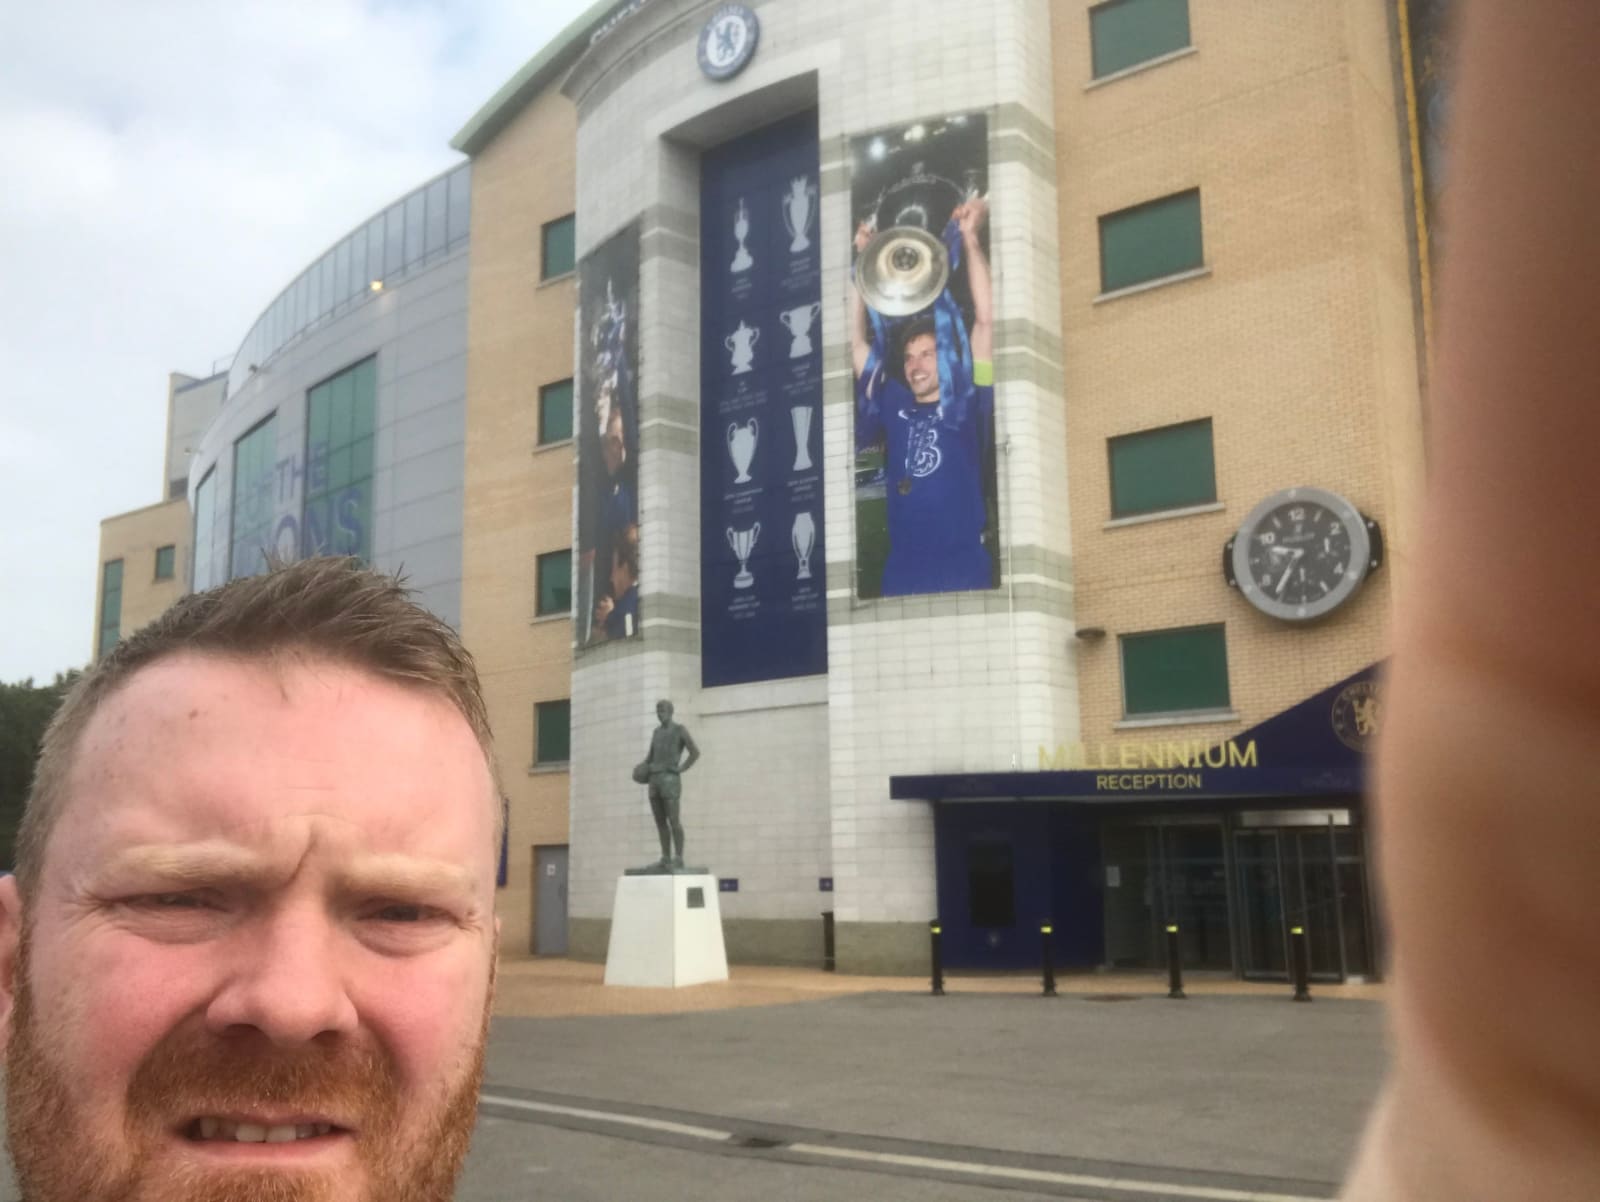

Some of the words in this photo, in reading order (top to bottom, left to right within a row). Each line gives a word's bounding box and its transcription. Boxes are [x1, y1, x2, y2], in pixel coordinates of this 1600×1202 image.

[275, 440, 328, 505] THE
[1288, 508, 1305, 521] 12
[275, 487, 362, 565] ONS
[1330, 522, 1341, 536] 2
[1259, 532, 1276, 545] 10
[1333, 562, 1344, 575] 4
[1038, 740, 1258, 769] MILLENNIUM
[1096, 773, 1202, 791] RECEPTION
